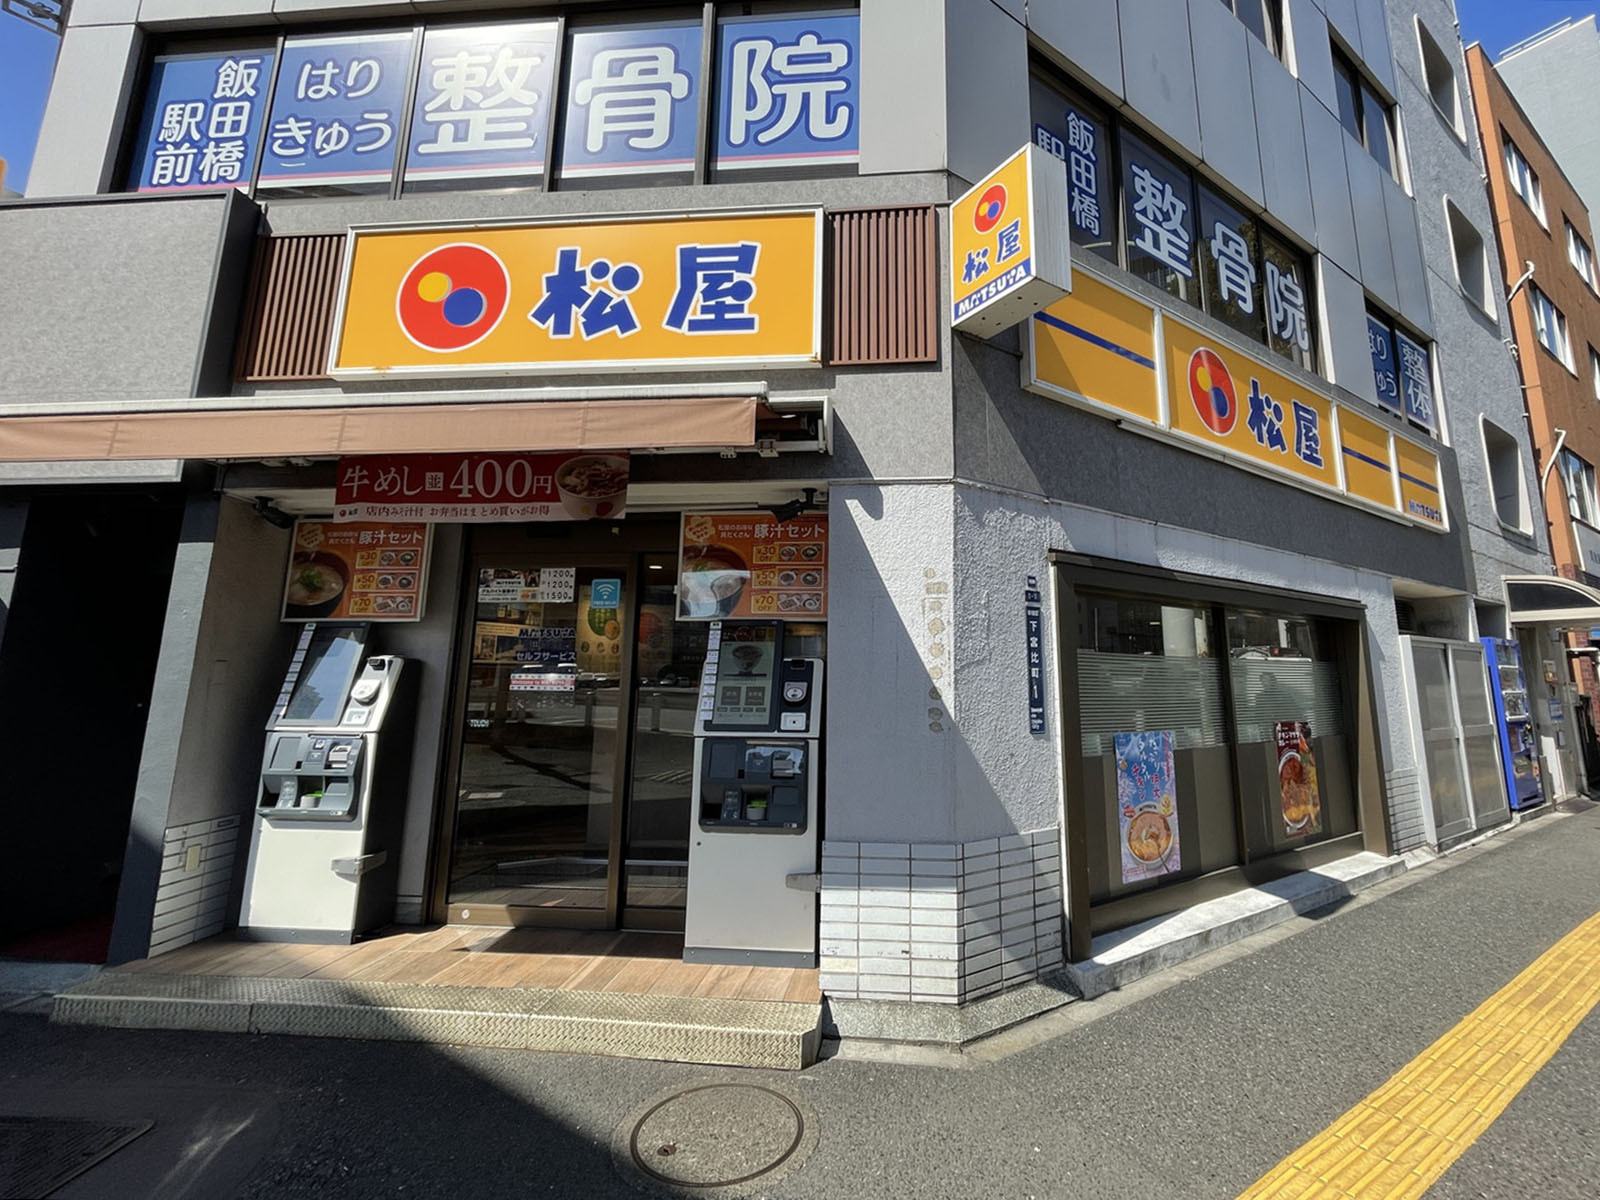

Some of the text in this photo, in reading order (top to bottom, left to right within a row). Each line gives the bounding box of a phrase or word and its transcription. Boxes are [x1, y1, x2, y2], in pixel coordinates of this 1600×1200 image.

[297, 57, 381, 100] はり
[419, 34, 853, 154] 整骨院
[151, 102, 202, 186] 駅前
[197, 57, 260, 182] 飯田橋
[270, 112, 394, 157] きゅう
[1066, 112, 1101, 236] 飯田橋
[958, 264, 1027, 315] MATSUYA
[962, 219, 1021, 284] 松屋
[1131, 163, 1309, 353] 整骨院
[531, 240, 760, 340] 松屋
[1401, 343, 1432, 419] 整体
[1247, 378, 1325, 469] 松屋
[359, 530, 423, 544] 豚汁セット
[754, 524, 825, 539] 豚汁セット
[516, 652, 576, 661] セルフサービス
